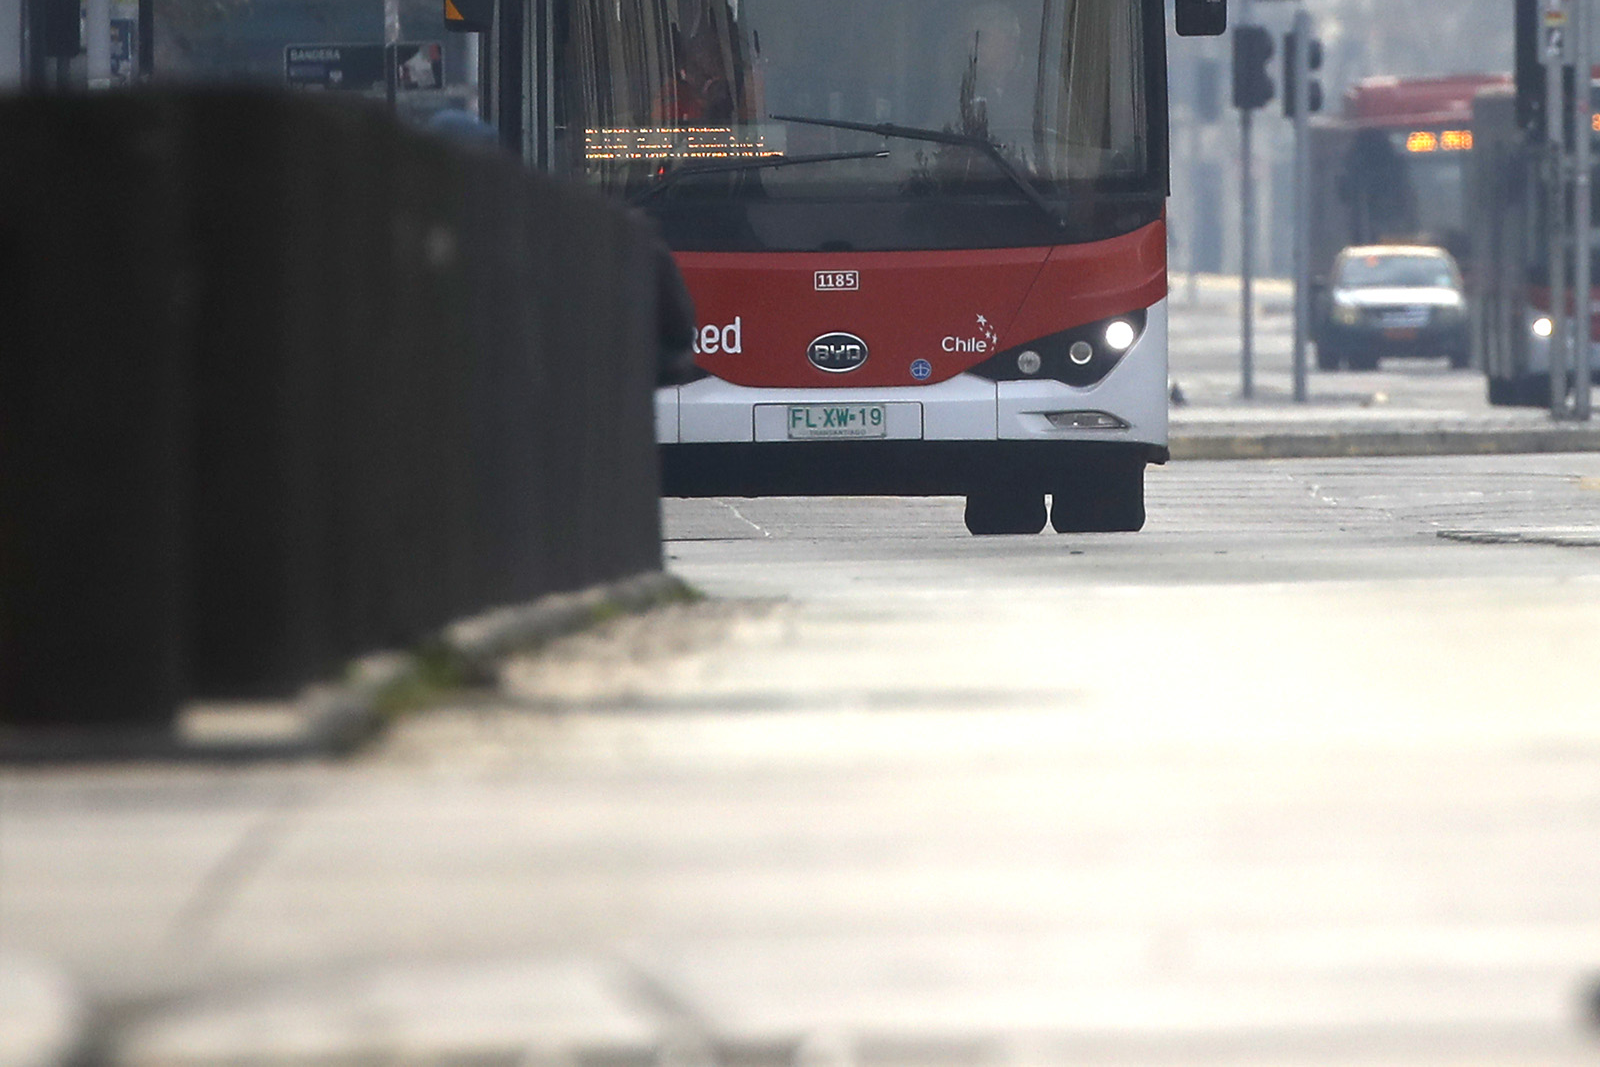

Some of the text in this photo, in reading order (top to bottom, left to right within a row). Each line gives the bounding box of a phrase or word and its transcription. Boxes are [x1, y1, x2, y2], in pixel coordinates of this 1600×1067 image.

[818, 274, 855, 288] 1185
[814, 344, 861, 361] BYD
[941, 336, 987, 353] Chile
